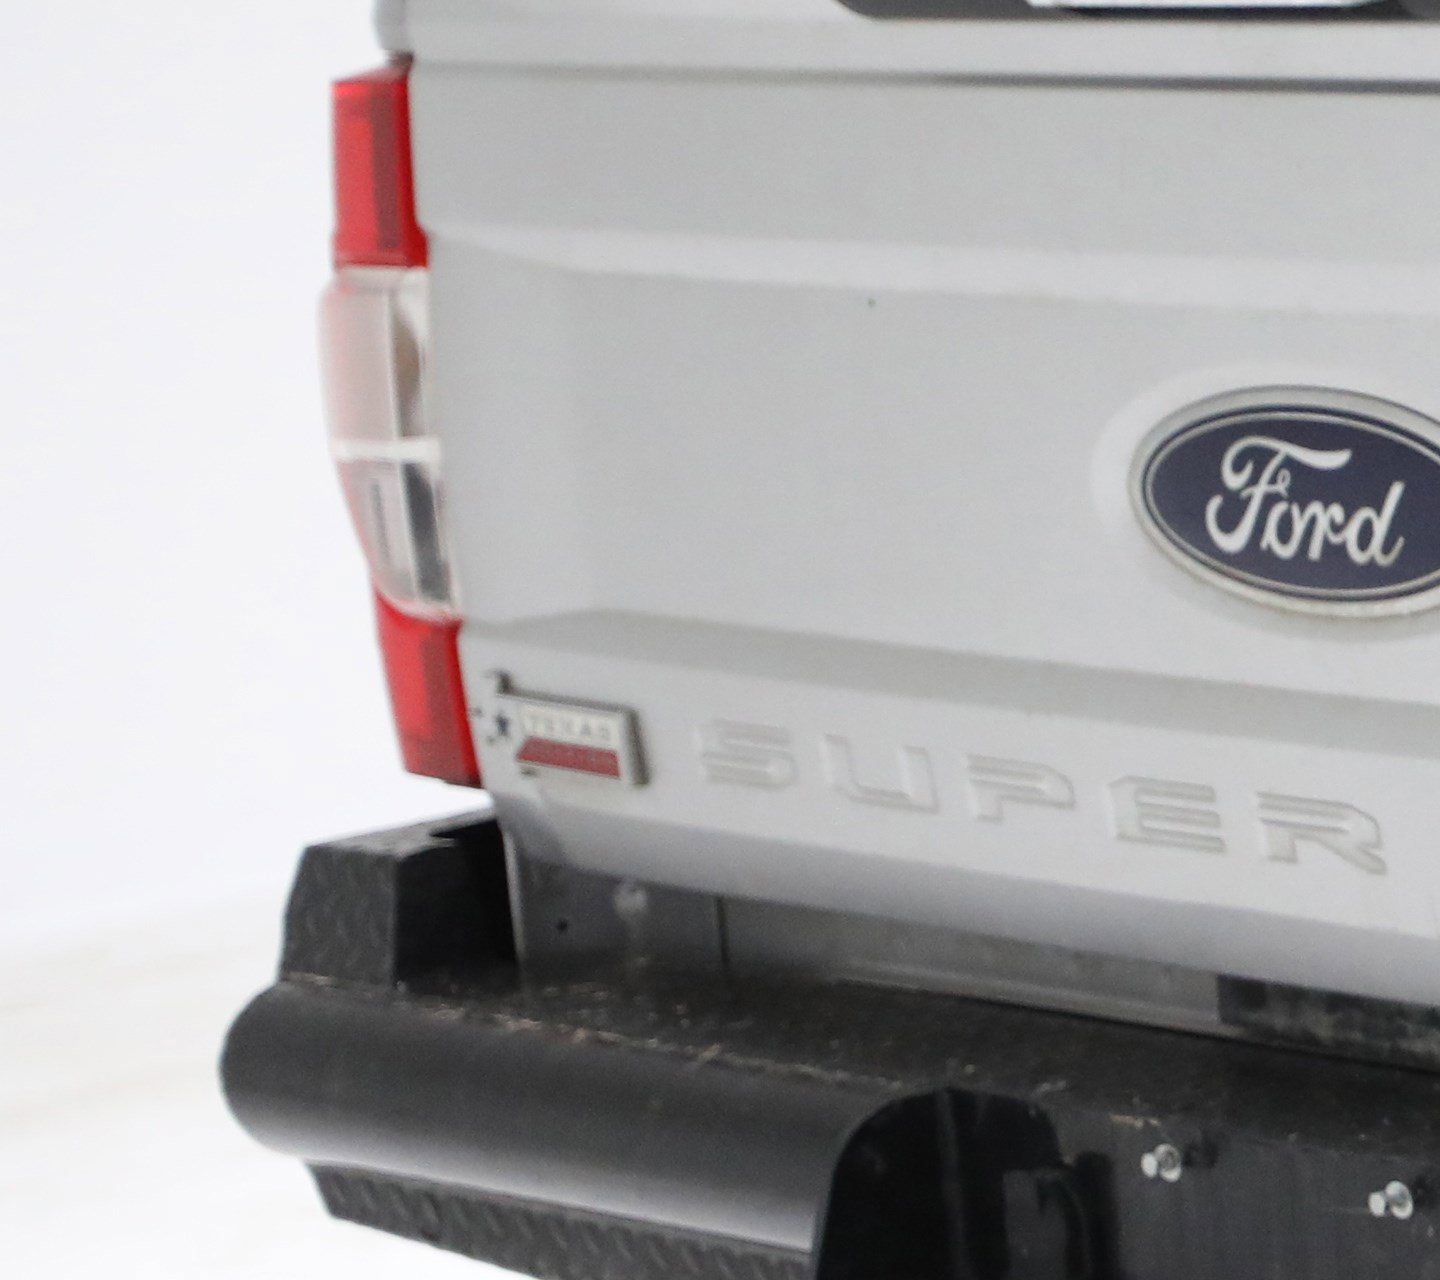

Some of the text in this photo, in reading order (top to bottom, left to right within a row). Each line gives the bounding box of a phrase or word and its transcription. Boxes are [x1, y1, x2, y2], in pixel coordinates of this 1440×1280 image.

[1205, 435, 1405, 567] Ford
[526, 714, 612, 742] TEXAS
[692, 717, 1388, 877] SUPER
